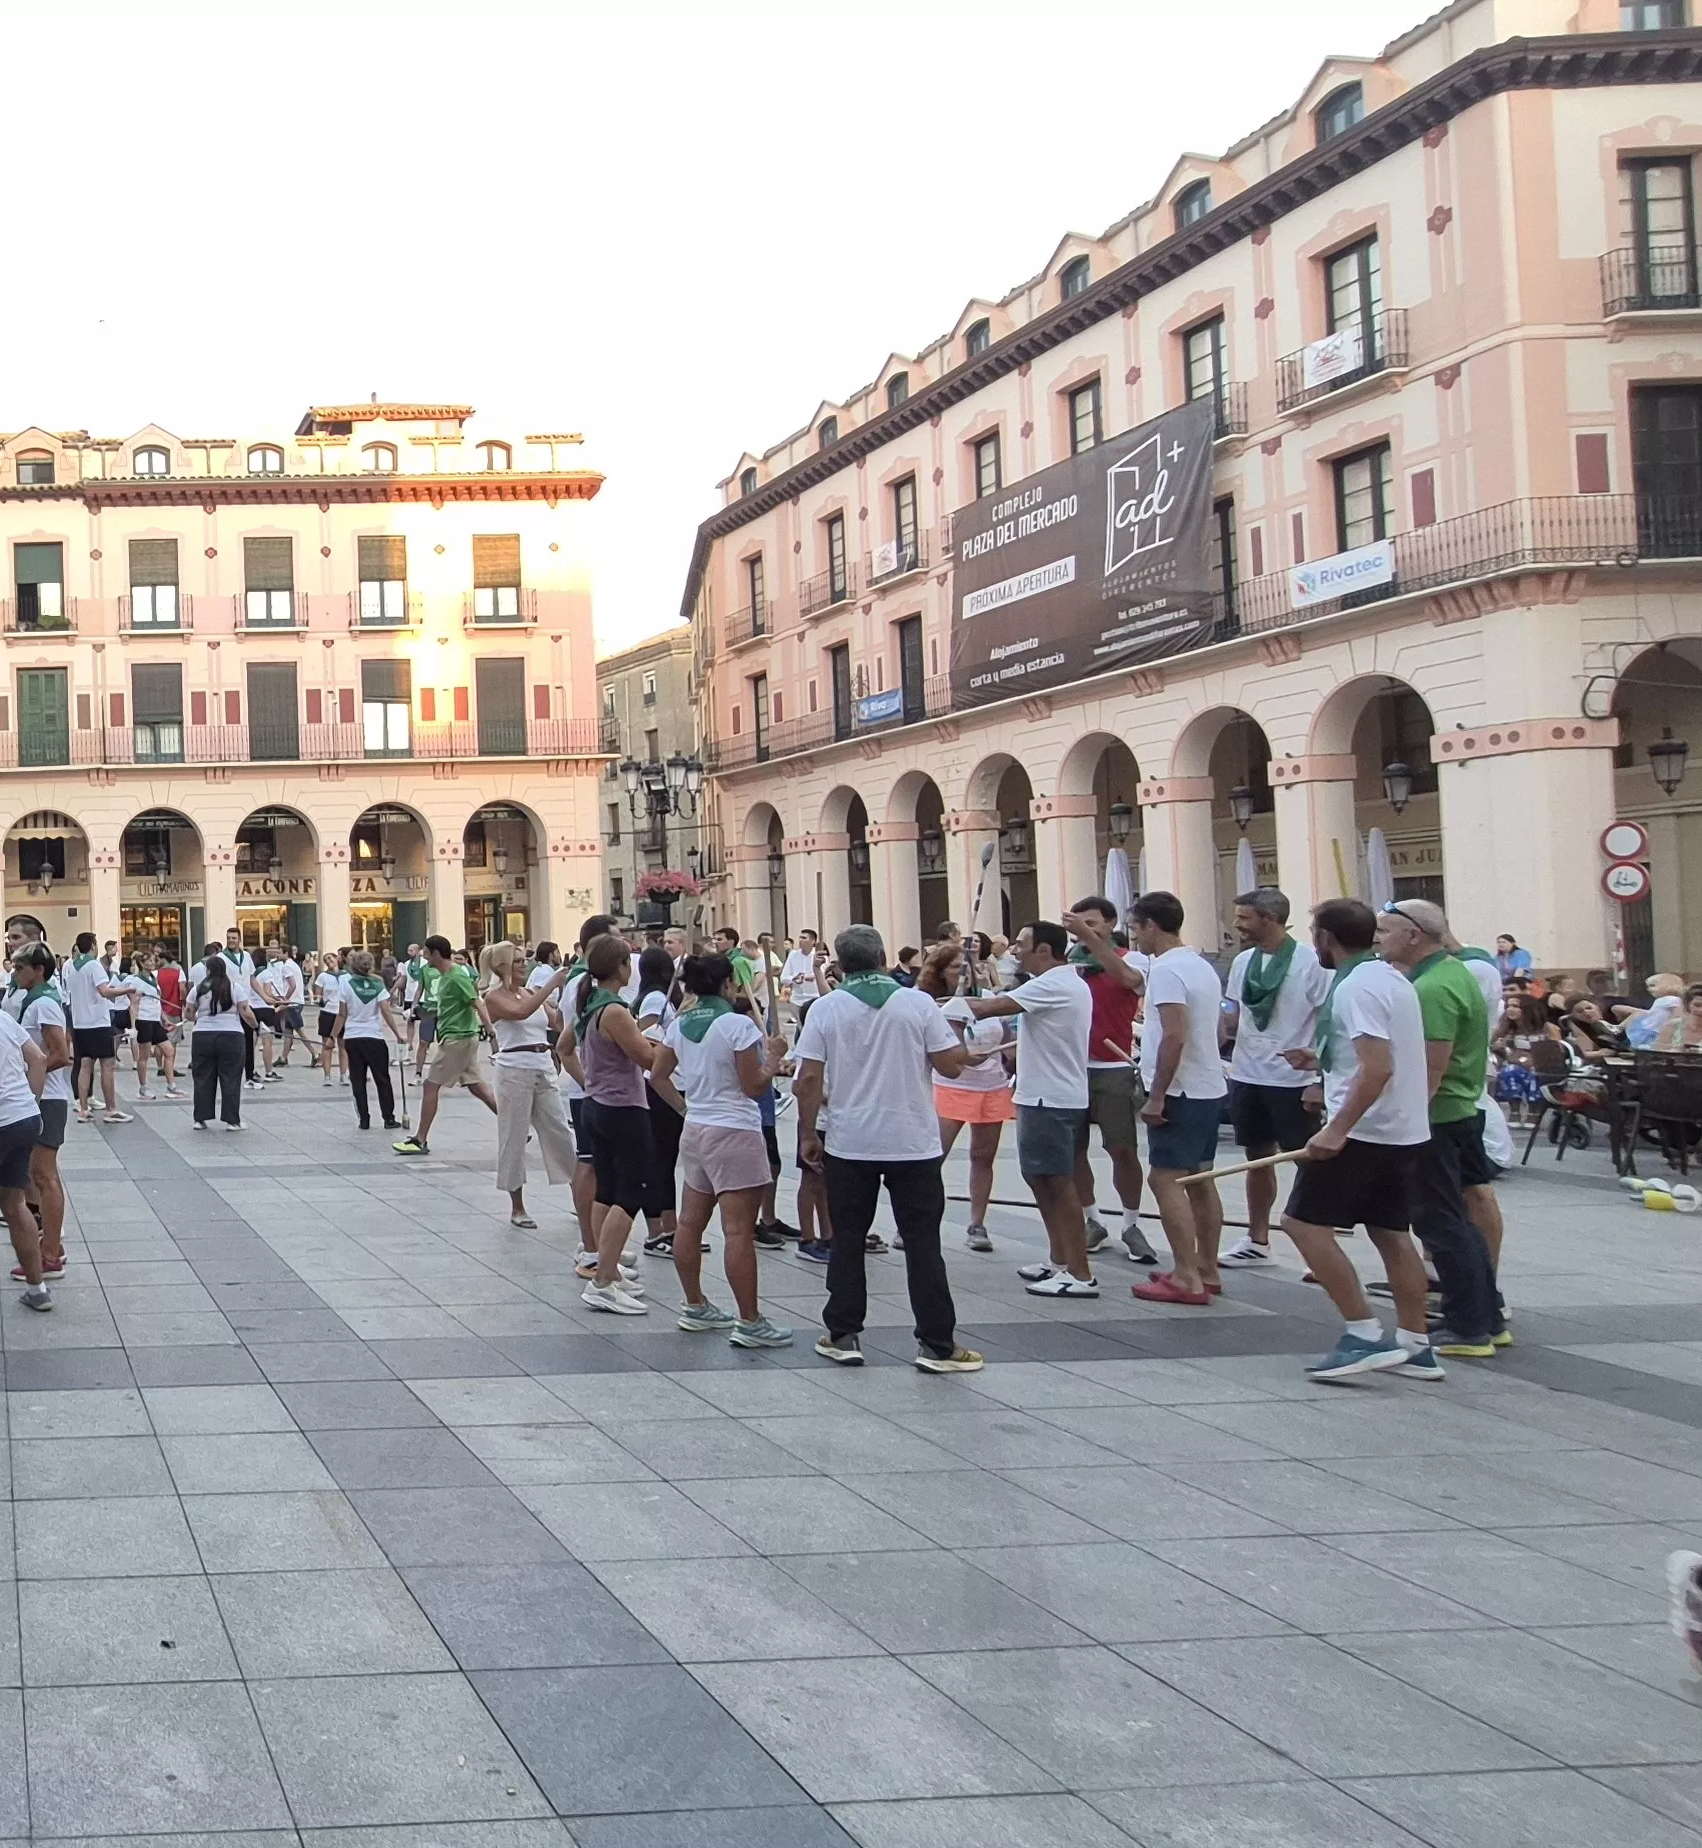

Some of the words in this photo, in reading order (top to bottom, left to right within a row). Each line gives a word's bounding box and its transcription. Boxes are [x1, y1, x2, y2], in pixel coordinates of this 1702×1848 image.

[992, 486, 1042, 522] COMPLEJO
[962, 530, 994, 562] PLAZA
[996, 521, 1017, 547] DEL
[1018, 494, 1078, 538] MERCADO
[1015, 563, 1069, 596] APERTURA
[1320, 556, 1383, 585] Rivatec
[989, 638, 1039, 661] Alojamiento
[970, 673, 994, 688] corta
[1000, 663, 1026, 680] media
[1026, 652, 1065, 673] estancia
